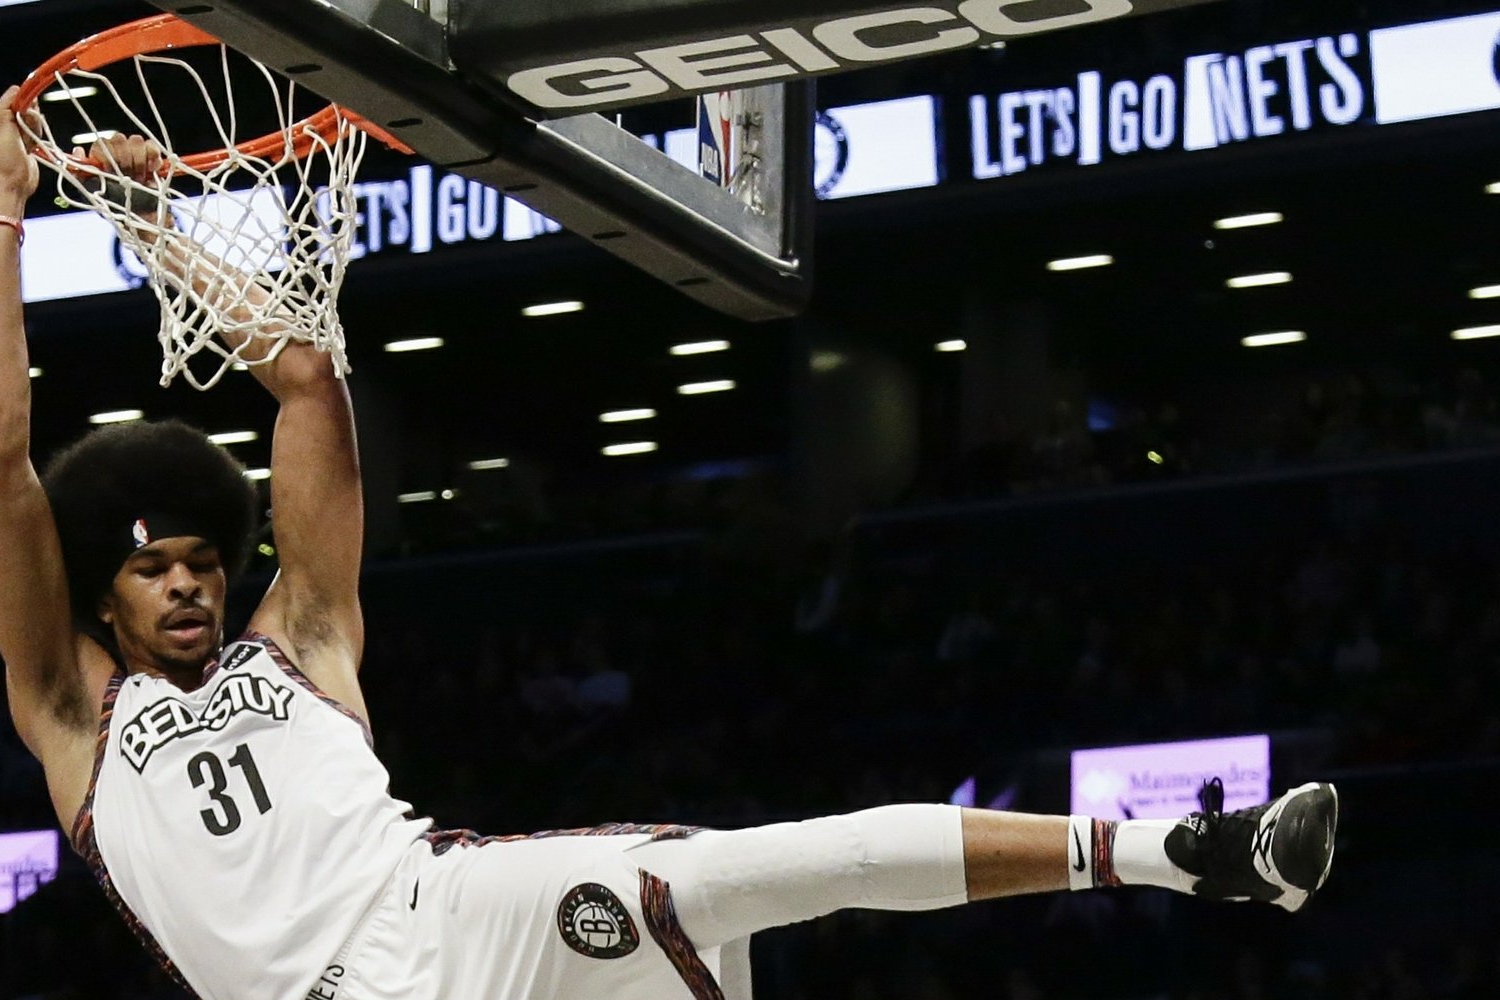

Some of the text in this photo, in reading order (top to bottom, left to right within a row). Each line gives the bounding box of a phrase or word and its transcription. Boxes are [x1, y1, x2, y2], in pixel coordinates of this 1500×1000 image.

[507, 0, 1134, 109] GEICO
[1108, 75, 1175, 154] GO
[1184, 33, 1363, 151] NETS
[187, 742, 273, 836] 31
